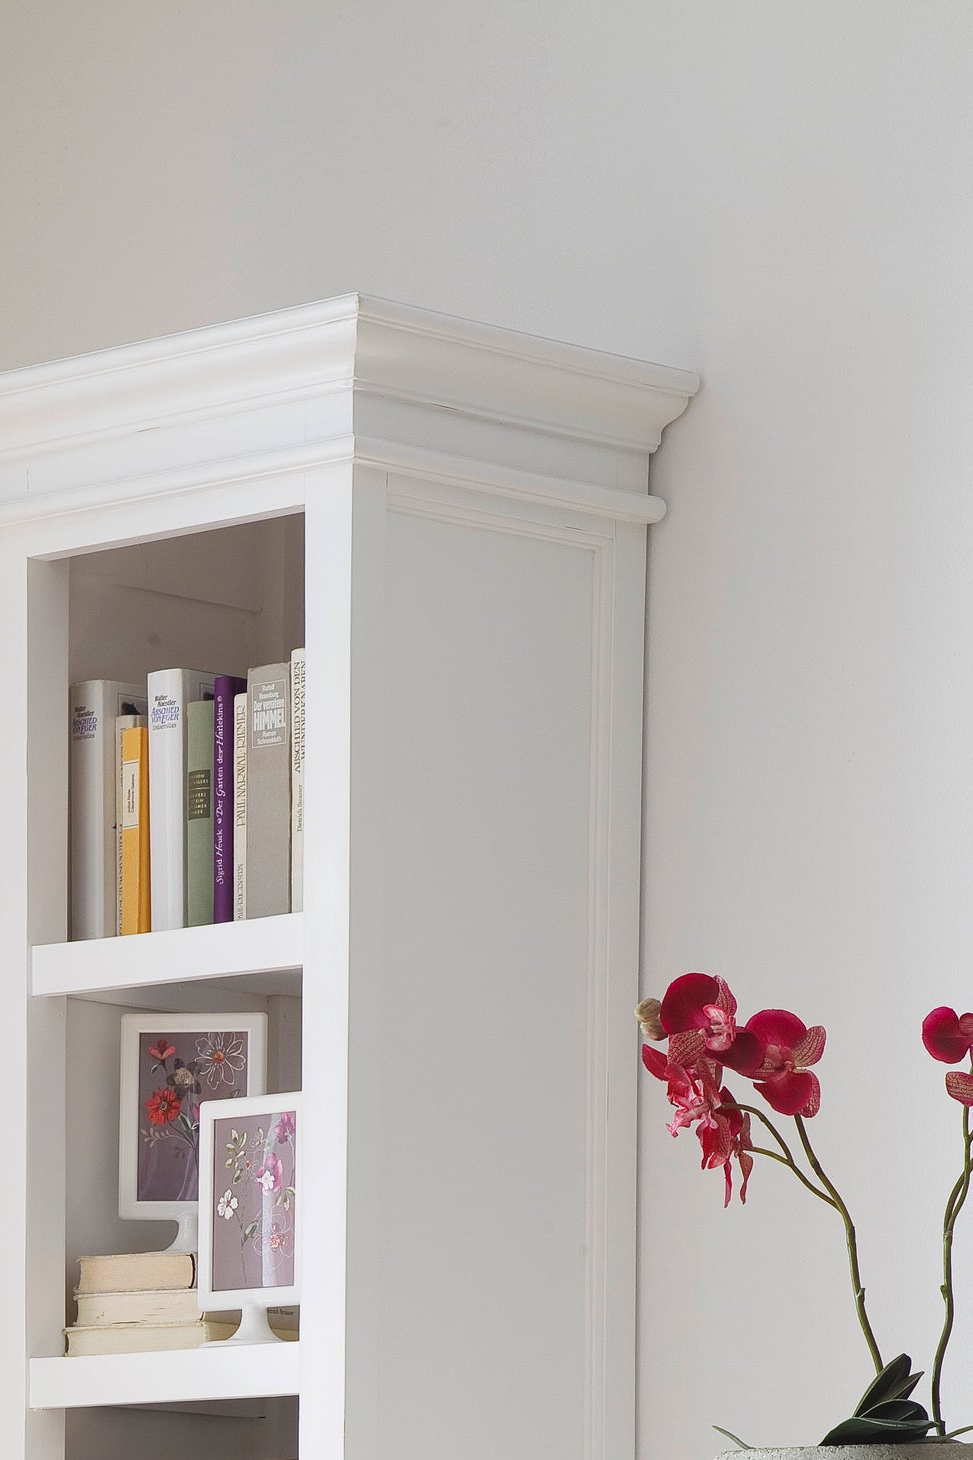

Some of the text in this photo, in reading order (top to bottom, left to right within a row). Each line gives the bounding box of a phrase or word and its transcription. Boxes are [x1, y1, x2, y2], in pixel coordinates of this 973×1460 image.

[253, 708, 286, 732] HIMMEL
[293, 661, 302, 774] ABSCHIED VON DEN
[215, 767, 226, 797] Garten
[216, 799, 225, 817] Der
[215, 829, 225, 857] Heuck
[215, 860, 225, 885] Sigrid
